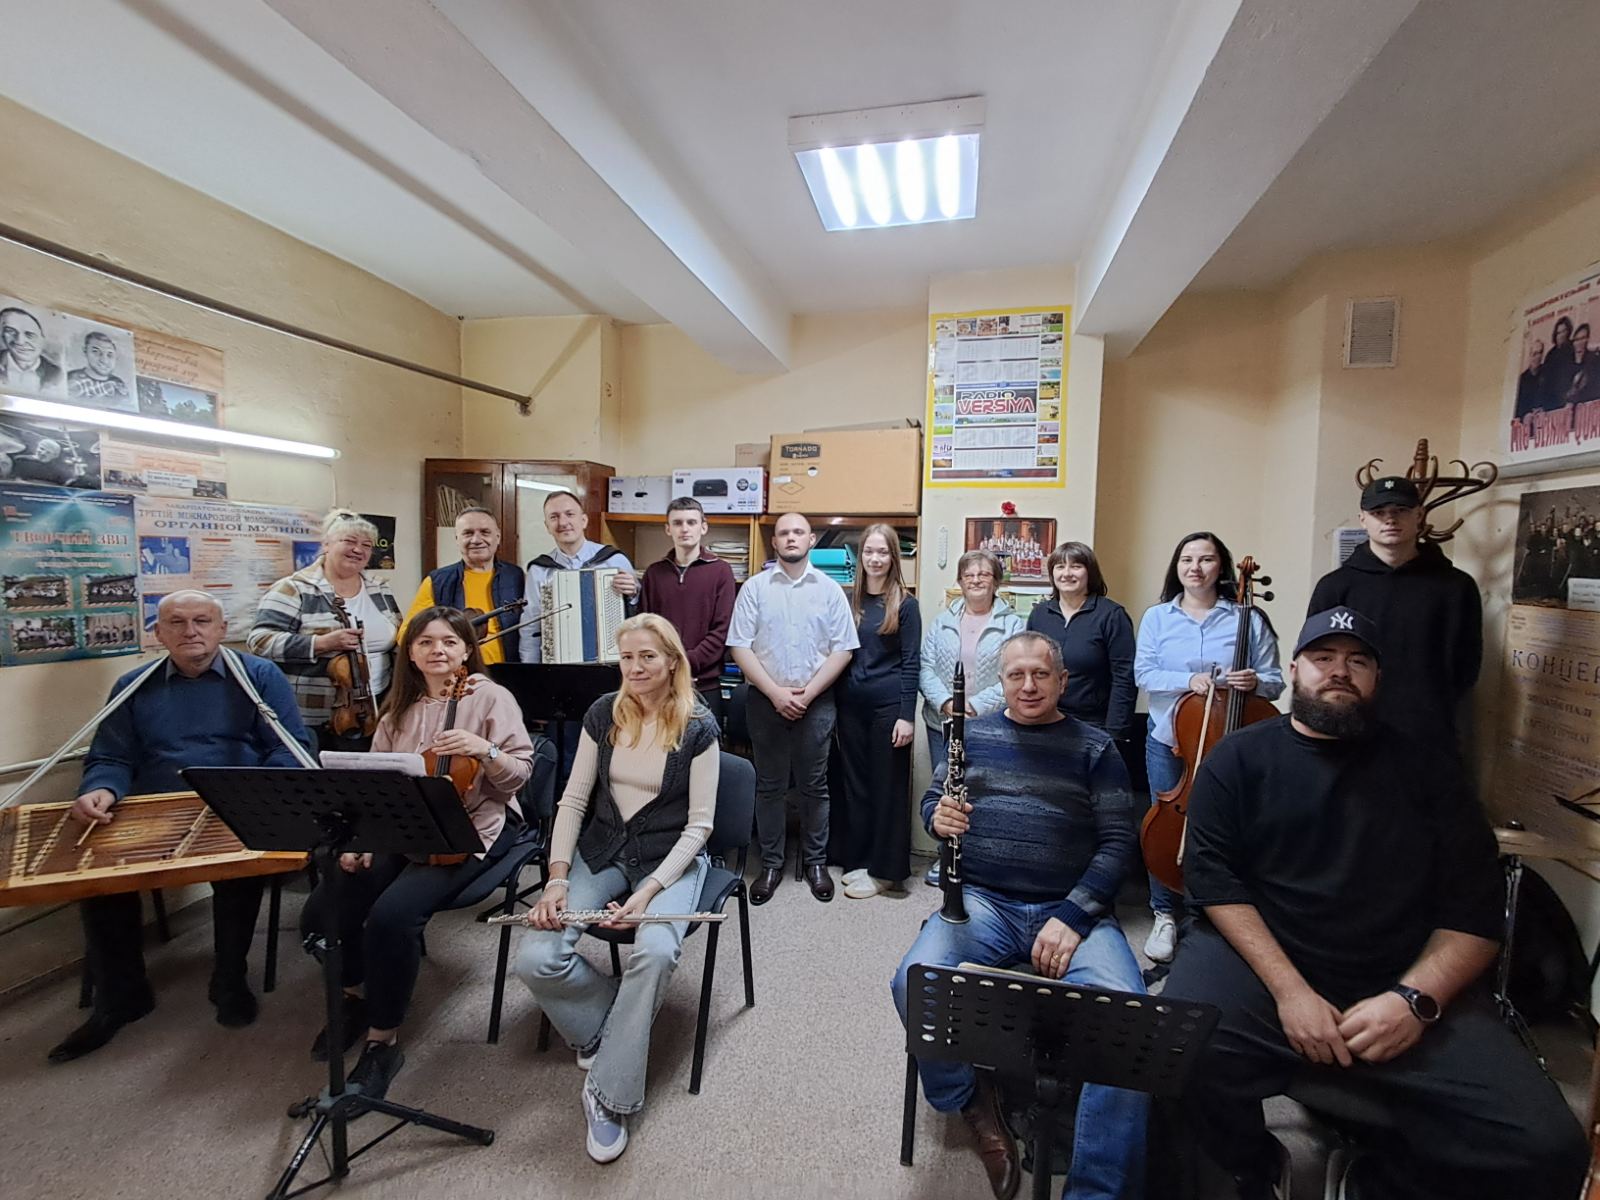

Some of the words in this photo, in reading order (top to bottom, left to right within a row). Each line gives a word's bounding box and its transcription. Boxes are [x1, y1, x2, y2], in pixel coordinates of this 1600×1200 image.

[961, 390, 1015, 400] RADIO
[957, 397, 1035, 415] VERSIYA
[785, 445, 818, 453] TORNADO
[154, 519, 242, 532] ОРГАННОЇ
[248, 524, 310, 535] МУЗИКИ
[1330, 611, 1353, 630] NY
